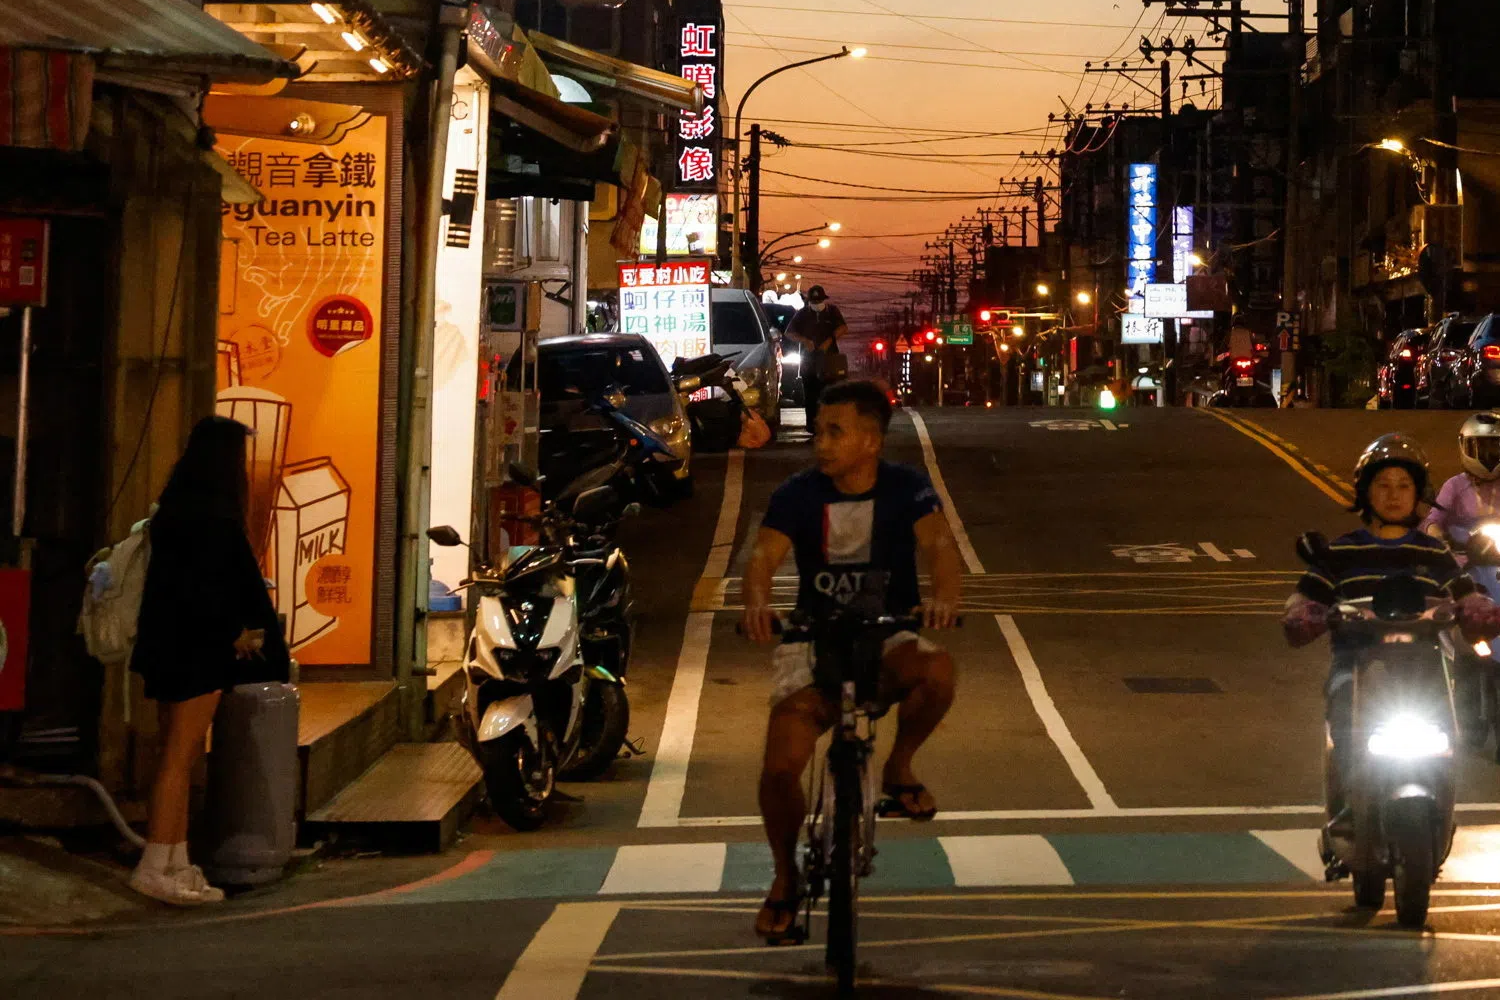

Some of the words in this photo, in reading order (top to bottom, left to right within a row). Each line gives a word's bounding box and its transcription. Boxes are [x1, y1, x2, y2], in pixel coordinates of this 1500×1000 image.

[248, 226, 296, 246] Tea
[307, 227, 375, 247] Latte
[624, 289, 705, 311] 蚵仔煎
[626, 312, 707, 334] 四神湯
[299, 528, 344, 567] MILK
